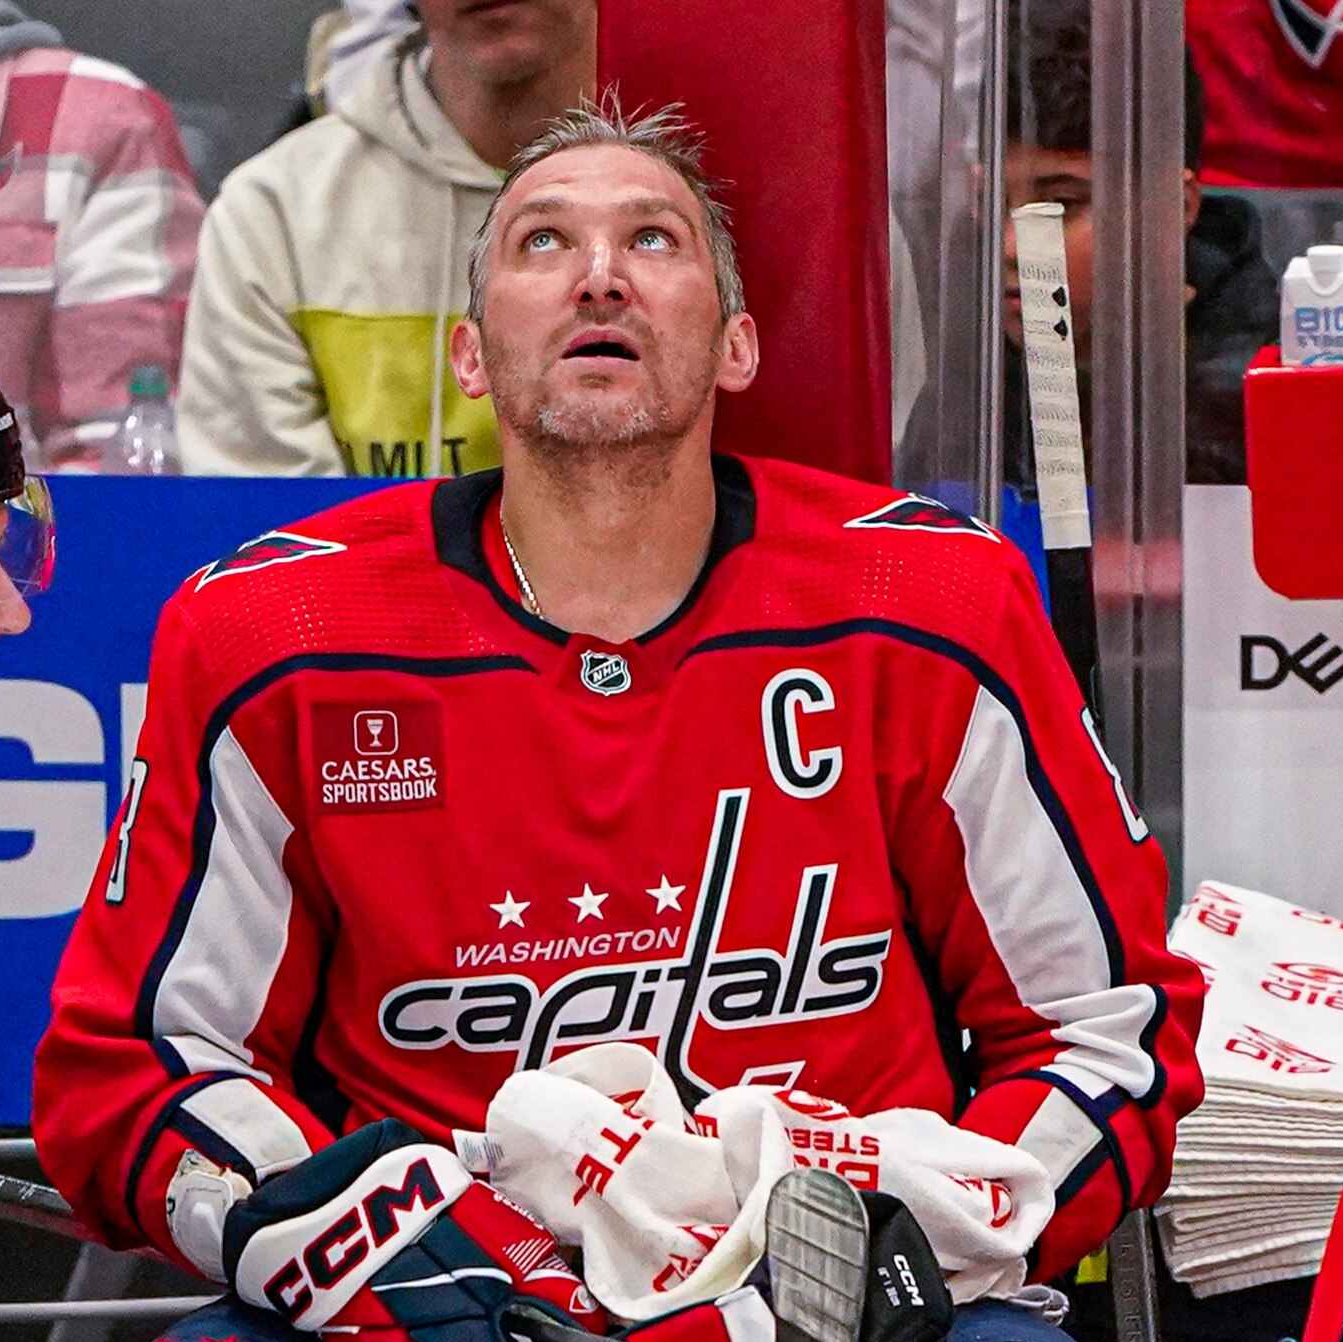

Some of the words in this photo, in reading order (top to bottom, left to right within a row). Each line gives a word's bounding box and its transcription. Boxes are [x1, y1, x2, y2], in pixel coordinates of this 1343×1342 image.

[592, 662, 621, 683] NHL
[762, 668, 844, 799] C
[321, 757, 436, 782] CAESARS
[322, 778, 438, 804] SPORTSBOOK
[455, 926, 682, 967] WASHINGTON
[785, 1127, 880, 1156] STEE
[262, 1156, 446, 1324] CCM
[893, 1254, 925, 1306] CCM
